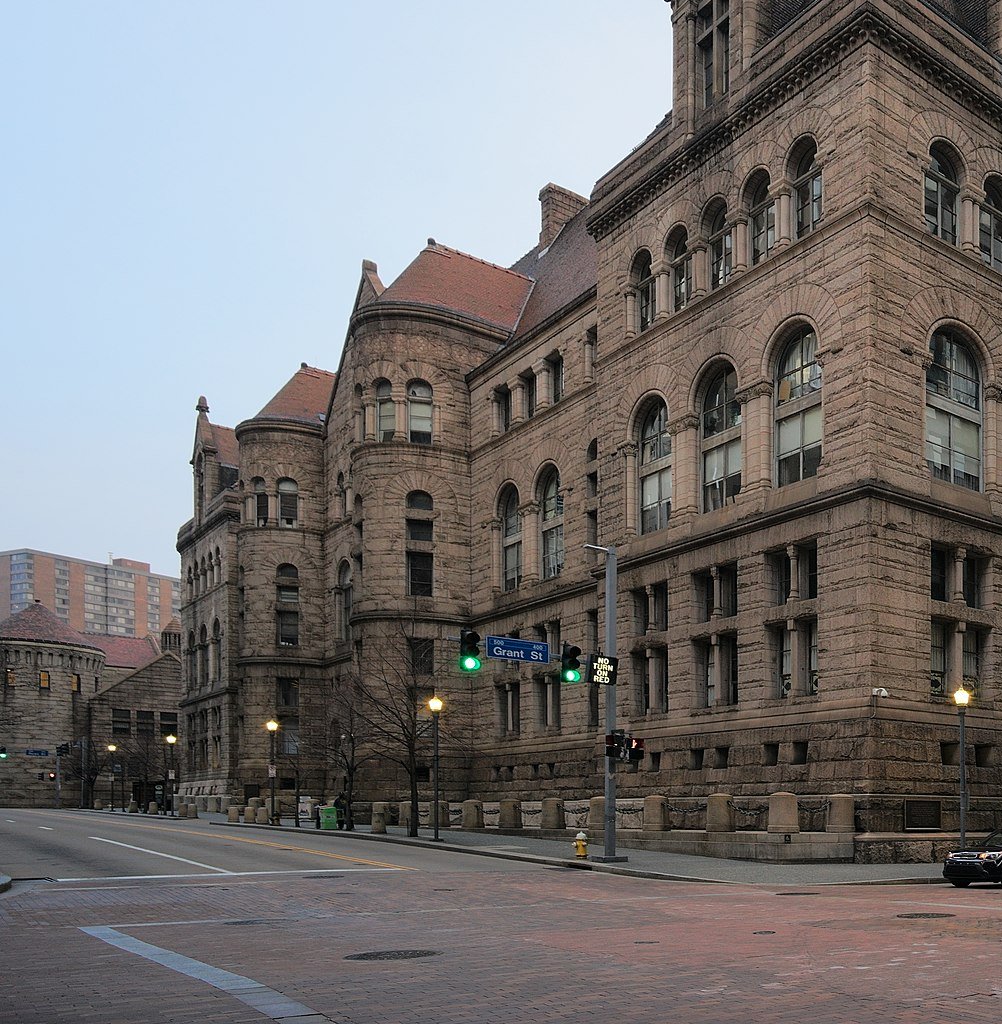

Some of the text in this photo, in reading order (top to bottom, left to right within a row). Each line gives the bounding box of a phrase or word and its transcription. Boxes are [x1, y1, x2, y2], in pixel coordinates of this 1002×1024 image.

[493, 647, 543, 661] Grant St
[597, 657, 609, 665] NO
[593, 663, 613, 672] TURN
[593, 676, 610, 684] RED
